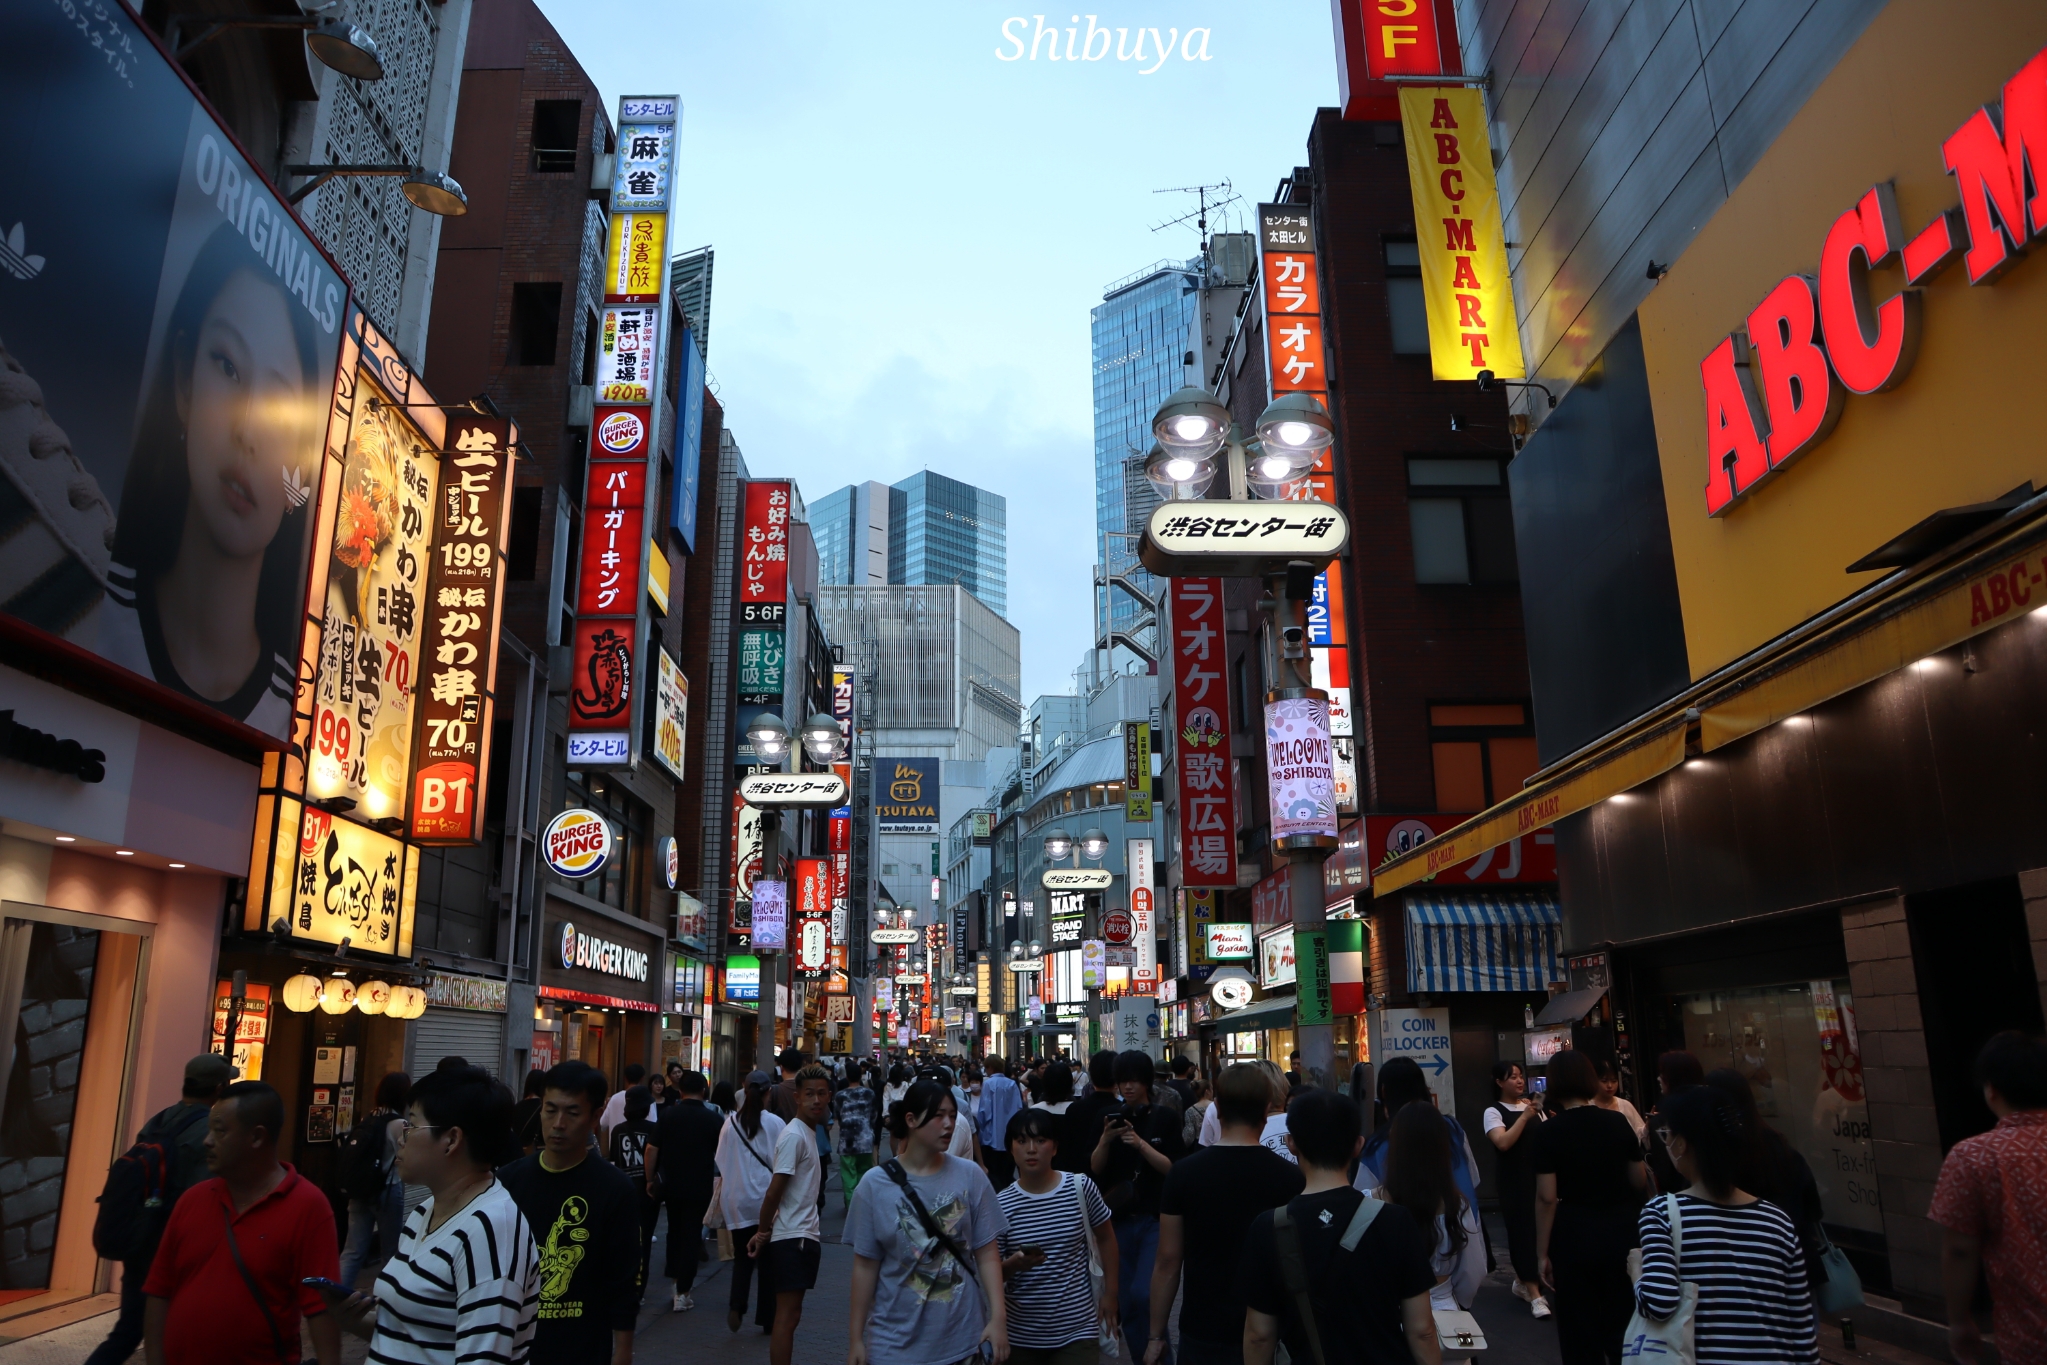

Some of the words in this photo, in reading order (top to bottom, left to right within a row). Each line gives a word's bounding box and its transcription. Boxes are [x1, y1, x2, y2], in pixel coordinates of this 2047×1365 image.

[624, 103, 674, 116] センタービル
[657, 125, 673, 134] 5F
[628, 136, 660, 194] 麻雀
[194, 133, 339, 334] ORIGINALS
[1265, 216, 1308, 227] センター街
[1430, 98, 1489, 367] ABC-MART
[1269, 230, 1307, 244] 太田ビル
[619, 219, 630, 285] TORIKIZOKU
[625, 295, 640, 303] 4F
[1275, 256, 1314, 385] カラオケ
[603, 384, 647, 401] 190円
[604, 419, 637, 434] BURGER
[605, 425, 638, 445] KING
[402, 458, 429, 503] 秘伝
[453, 426, 498, 537] 生ビール
[766, 489, 788, 562] お好み焼
[1159, 516, 1336, 538] 渋谷センター街
[598, 470, 628, 608] バーガーキング
[441, 542, 491, 568] 199
[746, 526, 765, 597] もんじゃ
[480, 568, 491, 578] 円
[437, 586, 486, 607] 秘伝
[1971, 553, 2047, 627] ABC-
[1179, 577, 1220, 702] ラオケ
[431, 611, 482, 707] かわ串
[742, 633, 762, 685] 無呼吸
[764, 633, 783, 685] いびき
[351, 633, 383, 788] 生ビール
[753, 694, 769, 704] 4F
[426, 719, 467, 748] 70
[464, 742, 475, 754] 円
[569, 740, 627, 757] センタービル
[1127, 725, 1138, 788] 全身もみほぐし
[1271, 737, 1329, 767] WELCOME
[1283, 767, 1333, 780] SHIBUYA
[420, 777, 468, 814] B1
[746, 782, 840, 795] 渋谷センター街
[875, 805, 935, 817] TSUTAYA
[1185, 752, 1229, 876] 歌広場
[1518, 795, 1560, 833] ABC-MART
[303, 812, 321, 843] B1
[551, 822, 602, 847] BURGER
[551, 833, 604, 864] KING
[1046, 875, 1109, 884] 渋谷センター街
[1051, 894, 1084, 914] MART
[1052, 919, 1082, 932] GRAND
[1052, 930, 1079, 943] STAGE
[1106, 922, 1130, 934] 消火栓
[1210, 933, 1243, 942] Miami
[576, 932, 623, 976] BURGER
[623, 948, 648, 982] KING
[1138, 982, 1151, 991] B1
[1313, 937, 1329, 1019] 客引きは犯罪です
[826, 996, 851, 1021] 豚
[1124, 1013, 1139, 1046] 抹茶
[1402, 1018, 1436, 1032] COIN
[1394, 1036, 1449, 1051] LOCKER
[563, 1301, 583, 1309] YEAR
